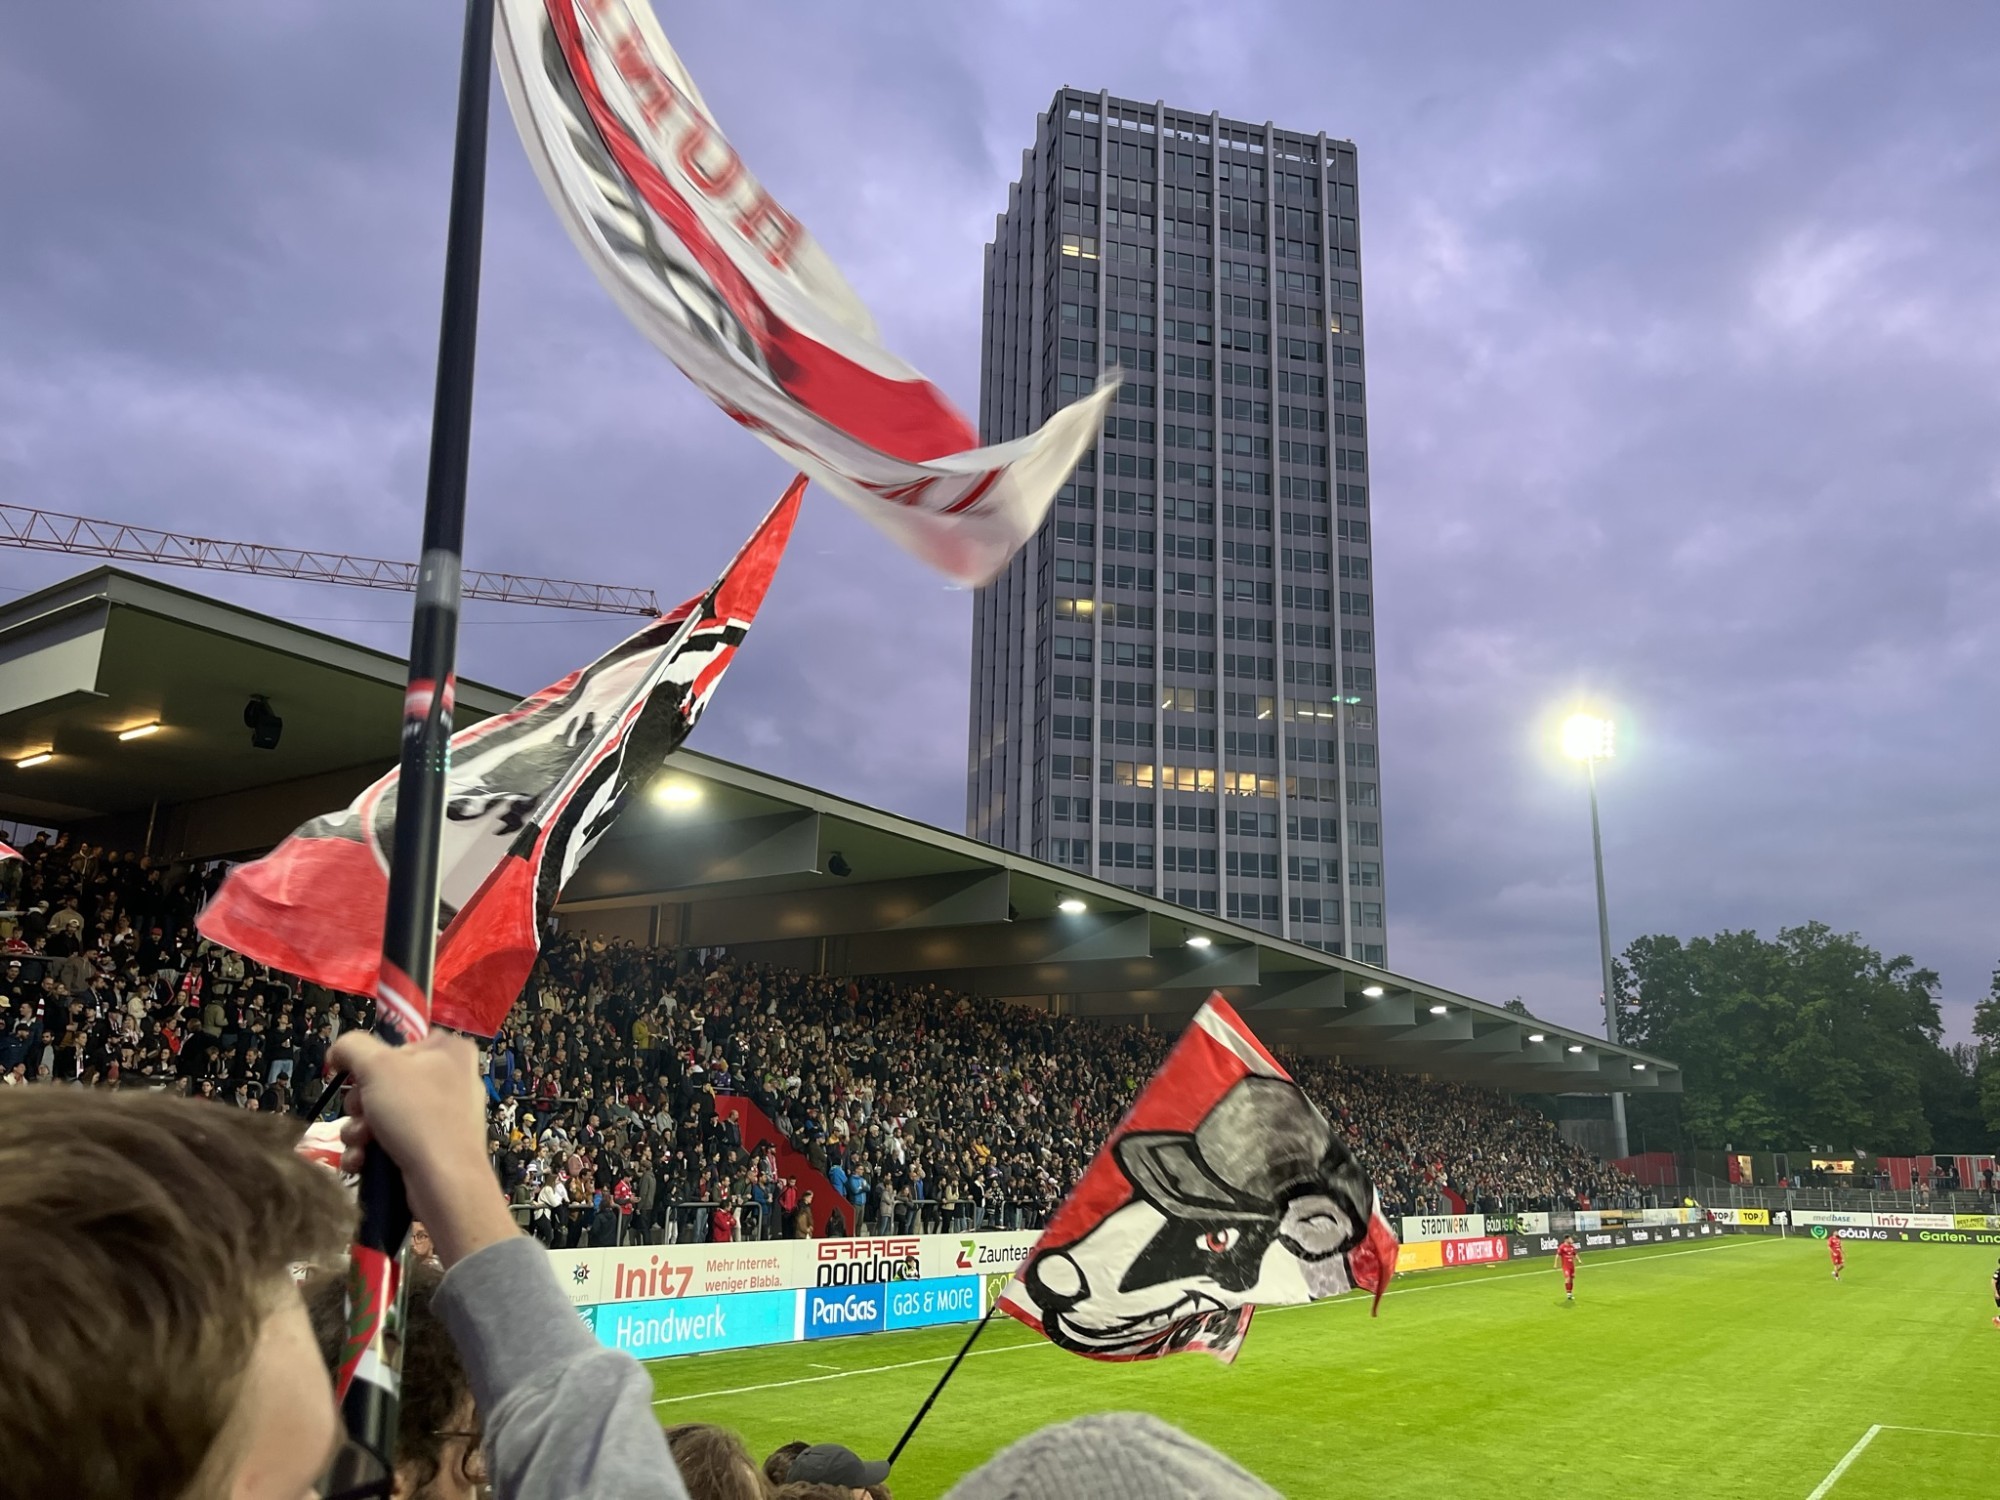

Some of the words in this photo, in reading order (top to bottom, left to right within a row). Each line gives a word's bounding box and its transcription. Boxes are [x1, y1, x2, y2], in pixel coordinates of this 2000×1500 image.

[1486, 1216, 1501, 1231] GÖLDI
[1502, 1218, 1509, 1231] AG
[1743, 1213, 1759, 1221] TOP
[1877, 1214, 1909, 1228] Init7
[1838, 1228, 1870, 1239] GÖLDI
[1872, 1231, 1888, 1240] AG
[1920, 1231, 1972, 1243] Garten-
[818, 1238, 920, 1261] GARAGE
[1457, 1242, 1466, 1260] FC
[706, 1259, 734, 1273] Mehr
[736, 1257, 780, 1270] Internet,
[614, 1254, 694, 1299] Init7
[705, 1278, 748, 1293] weniger
[750, 1274, 783, 1289] Blabla.
[812, 1294, 877, 1326] PanGas
[893, 1292, 920, 1316] Gas
[923, 1291, 935, 1313] &
[937, 1287, 973, 1311] More
[616, 1303, 727, 1349] Handwerk
